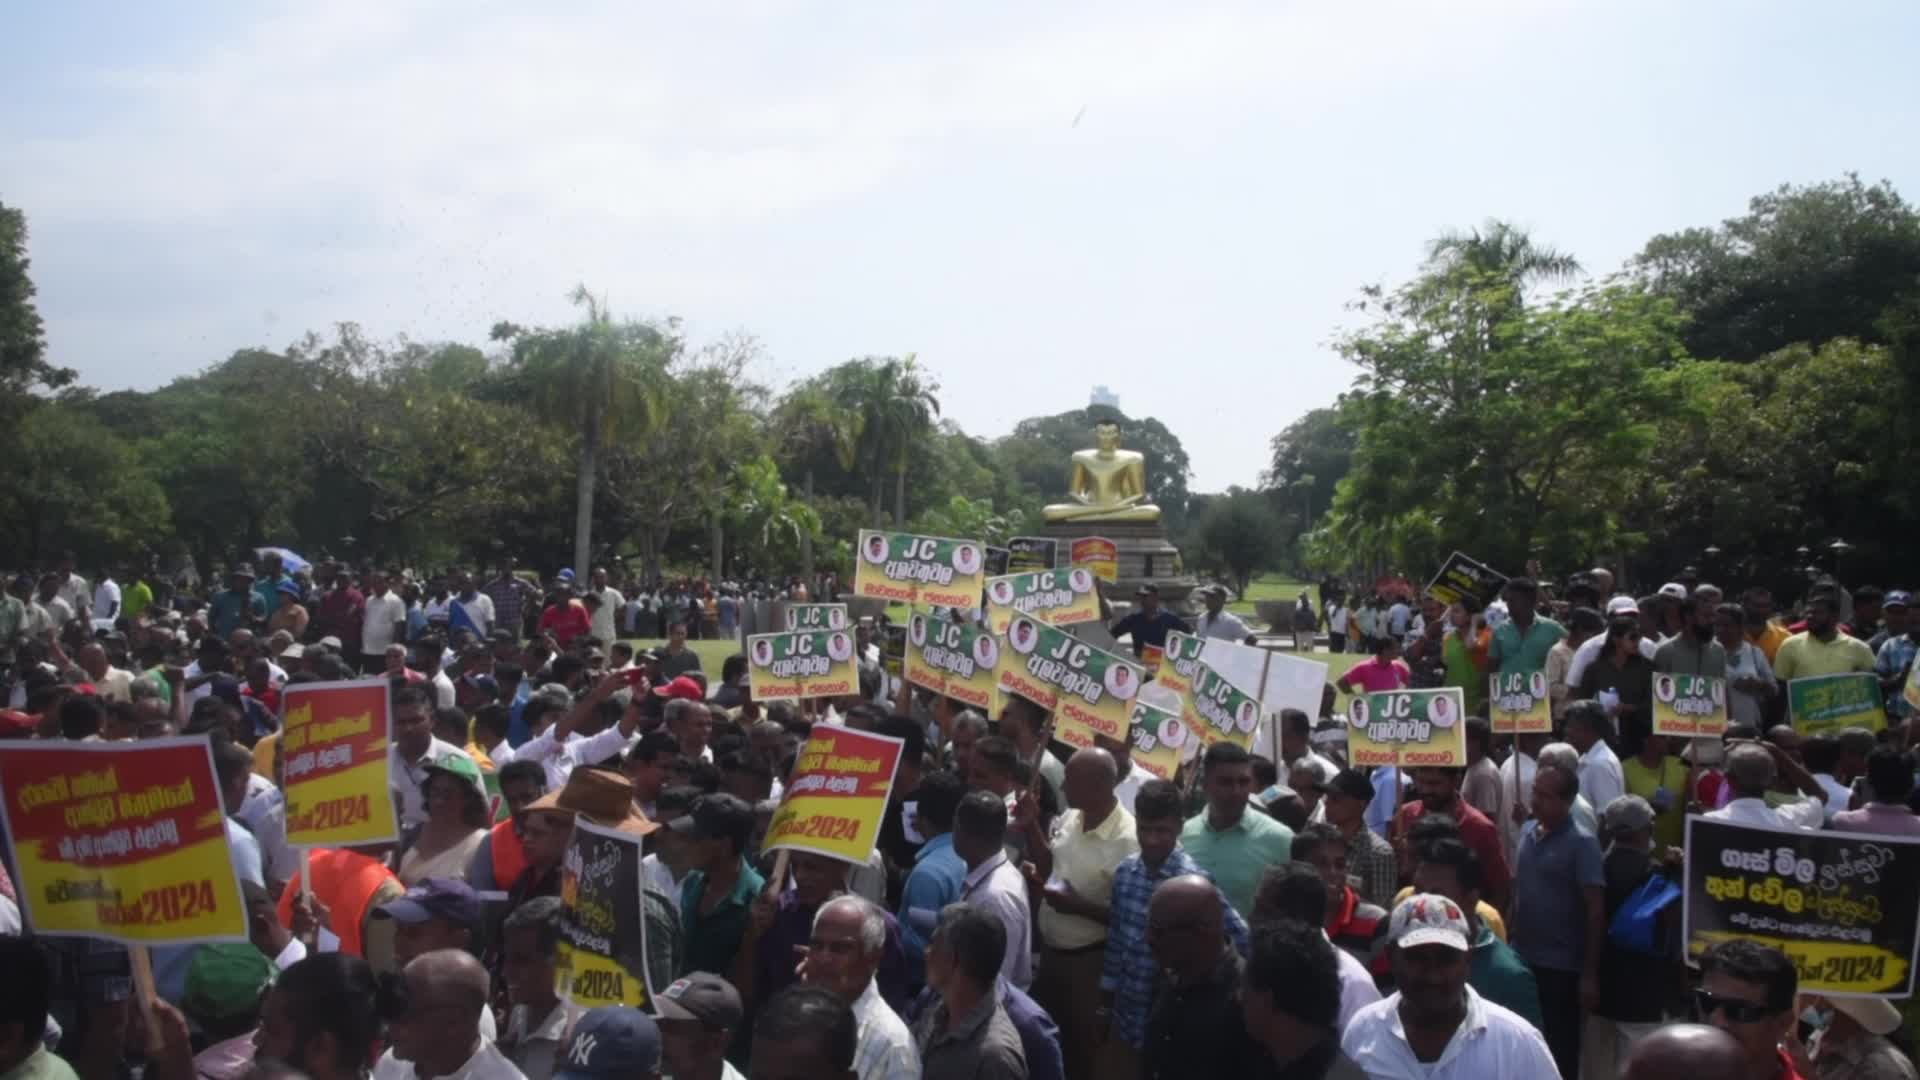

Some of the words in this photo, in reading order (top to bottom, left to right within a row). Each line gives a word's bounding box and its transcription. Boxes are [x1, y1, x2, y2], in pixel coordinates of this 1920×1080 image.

[903, 539, 937, 560] JC
[1026, 572, 1054, 592] JC
[803, 607, 820, 624] JC
[784, 634, 813, 655] JC
[935, 624, 960, 648] JC
[1051, 639, 1091, 668] JC
[1209, 679, 1232, 704] JC
[1505, 672, 1521, 691] JC
[1685, 676, 1705, 696] JC
[1381, 695, 1411, 717] JC
[1774, 847, 1816, 883] මිල
[143, 879, 217, 925] 2024
[1824, 956, 1886, 983] 2024
[583, 969, 624, 999] 2024
